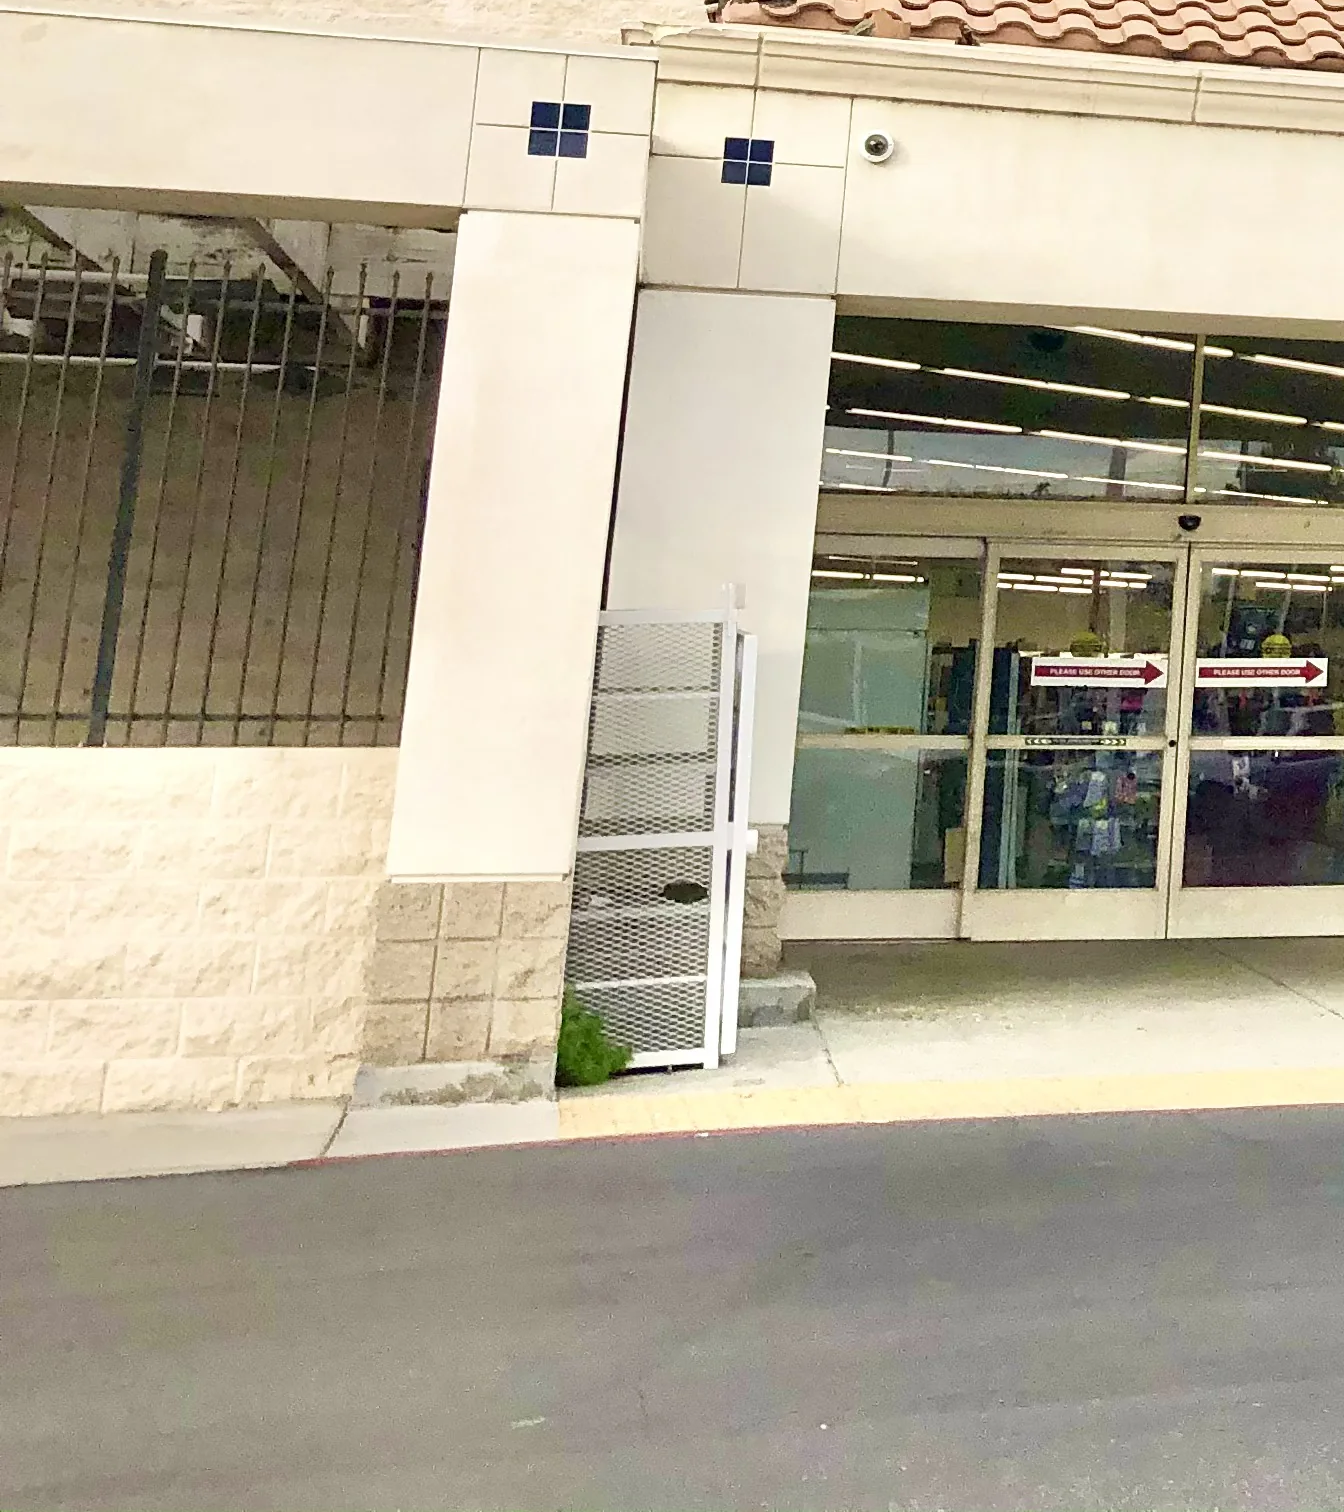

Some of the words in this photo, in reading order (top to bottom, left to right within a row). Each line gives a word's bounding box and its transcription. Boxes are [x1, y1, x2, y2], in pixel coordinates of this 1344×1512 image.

[1049, 667, 1077, 675] PLEASE
[1078, 668, 1093, 676] USE
[1213, 668, 1240, 676] PLEASE
